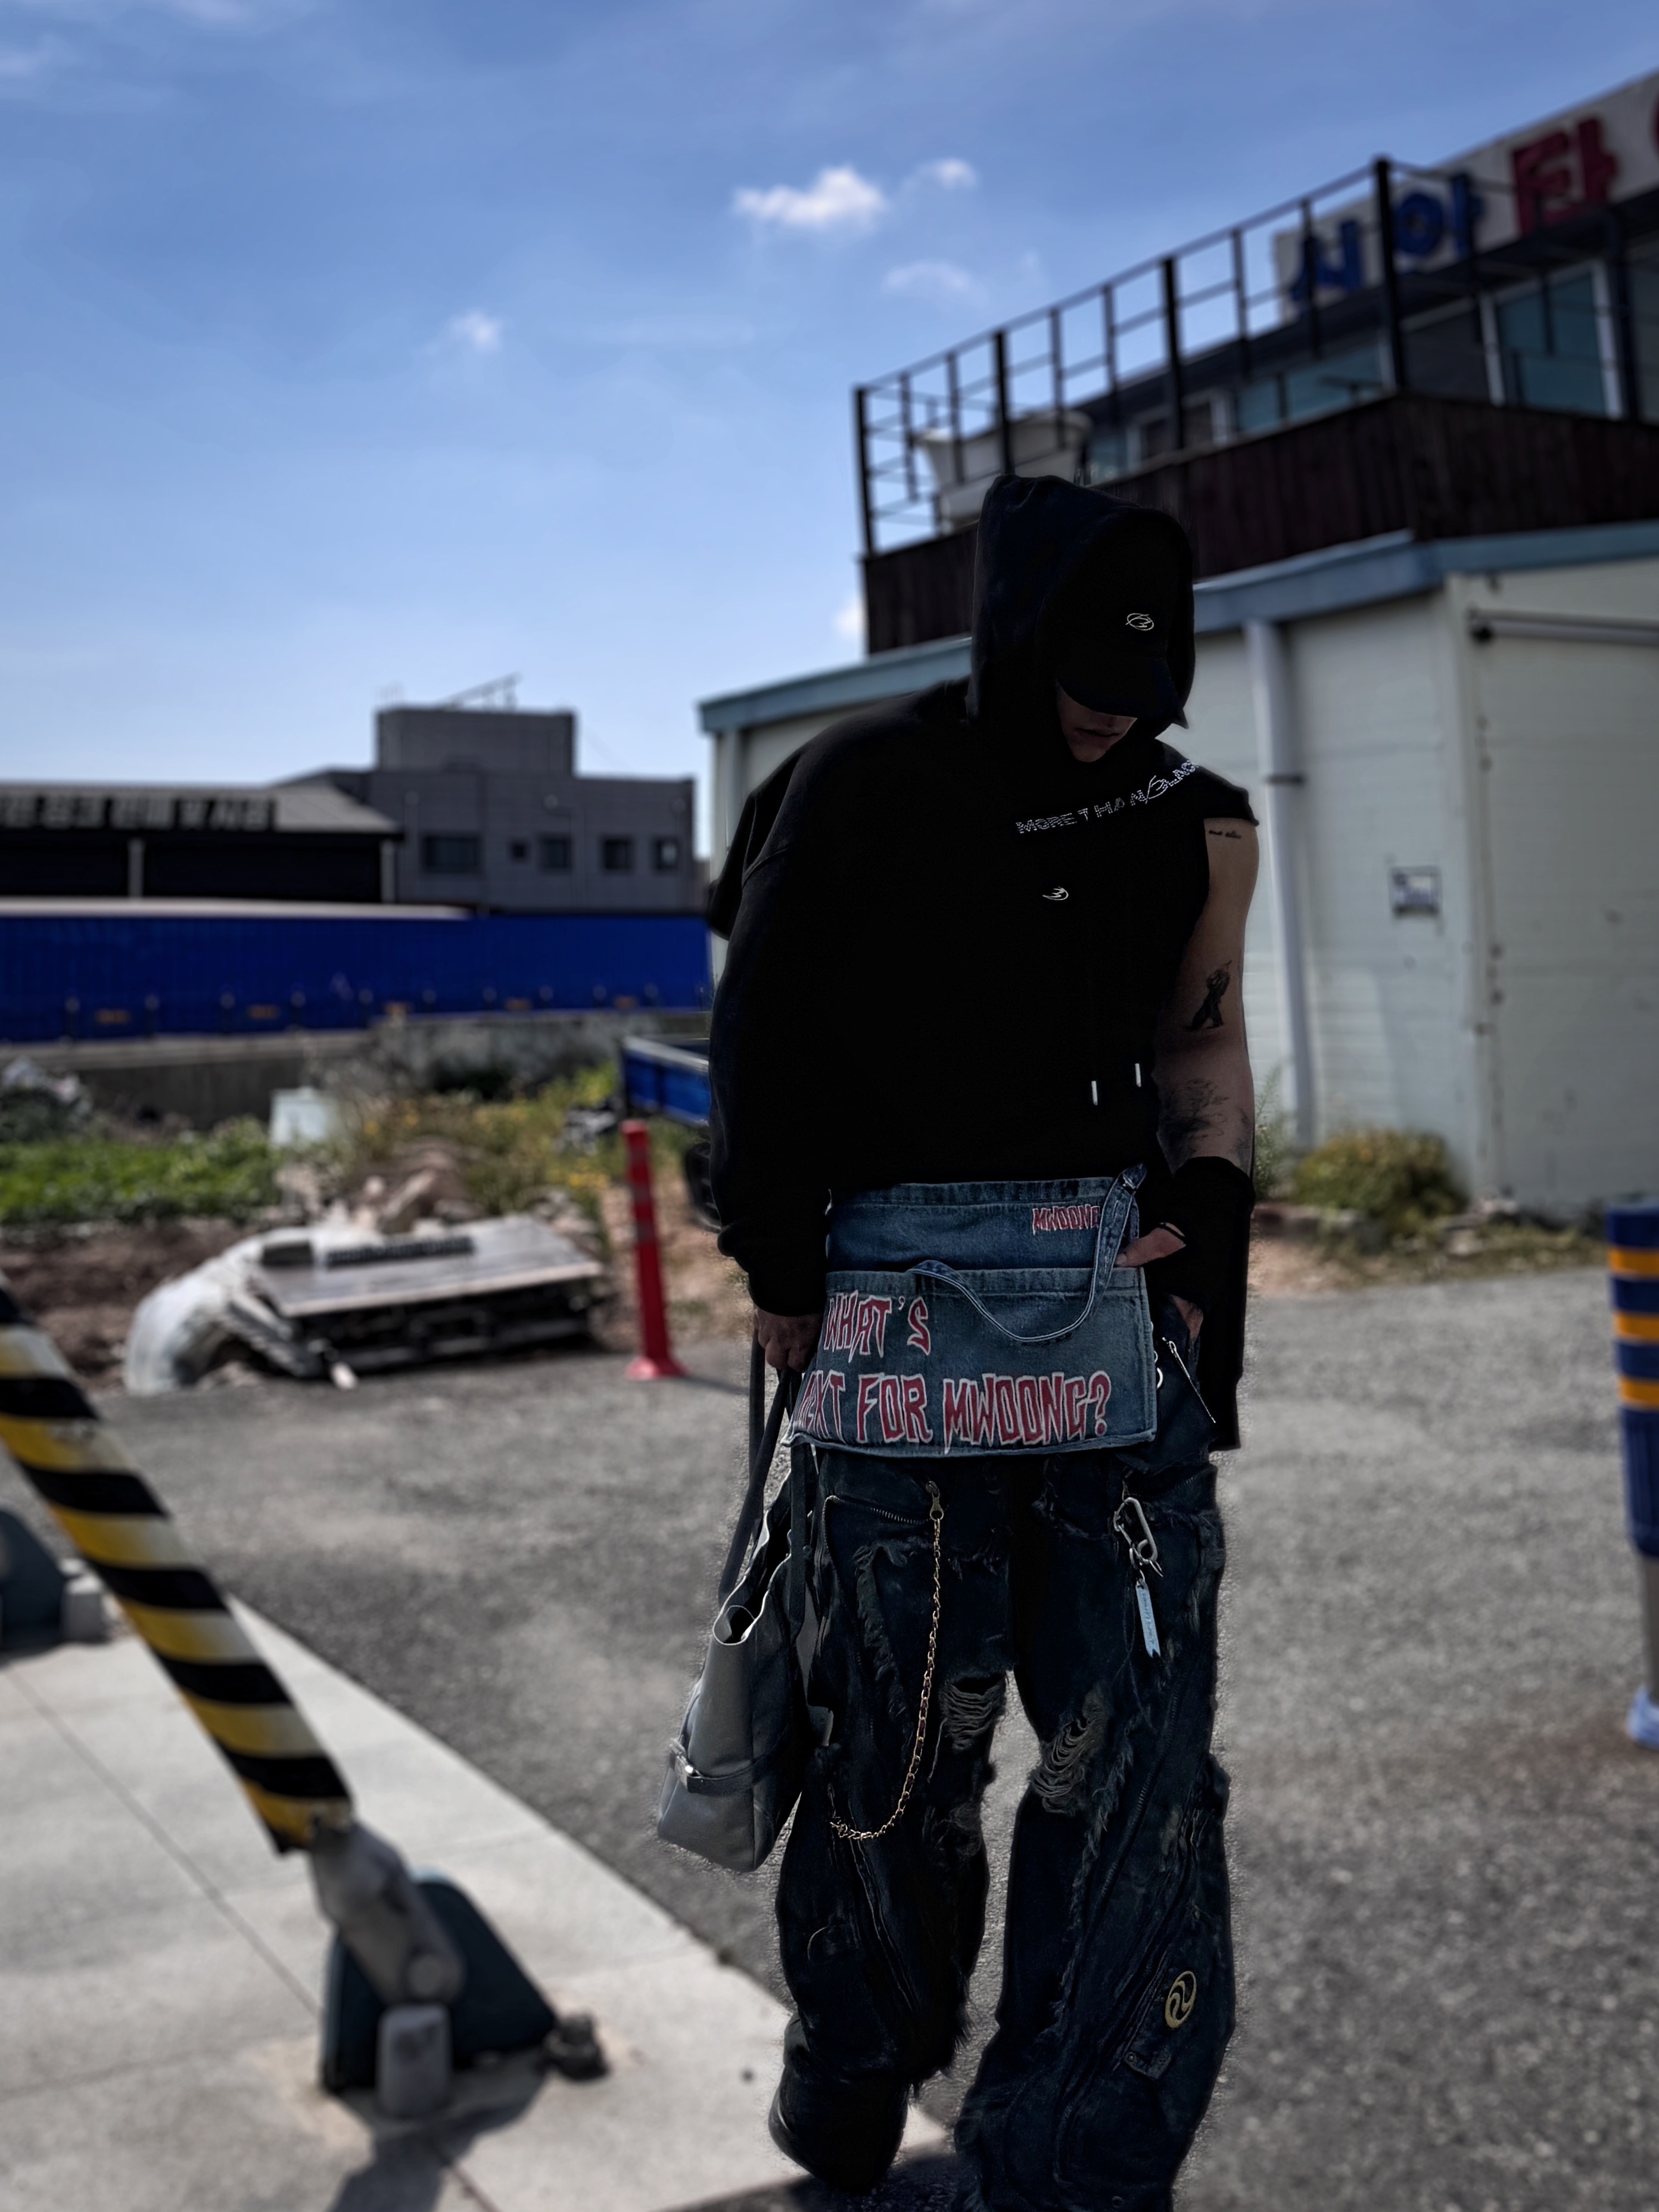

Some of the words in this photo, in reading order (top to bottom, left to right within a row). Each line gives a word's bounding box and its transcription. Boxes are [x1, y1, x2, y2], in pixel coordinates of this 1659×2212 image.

[1016, 812, 1078, 833] MORE
[824, 1290, 930, 1363] WHAT'S
[857, 1372, 933, 1443] FOR
[942, 1370, 1112, 1454] MWOONG?
